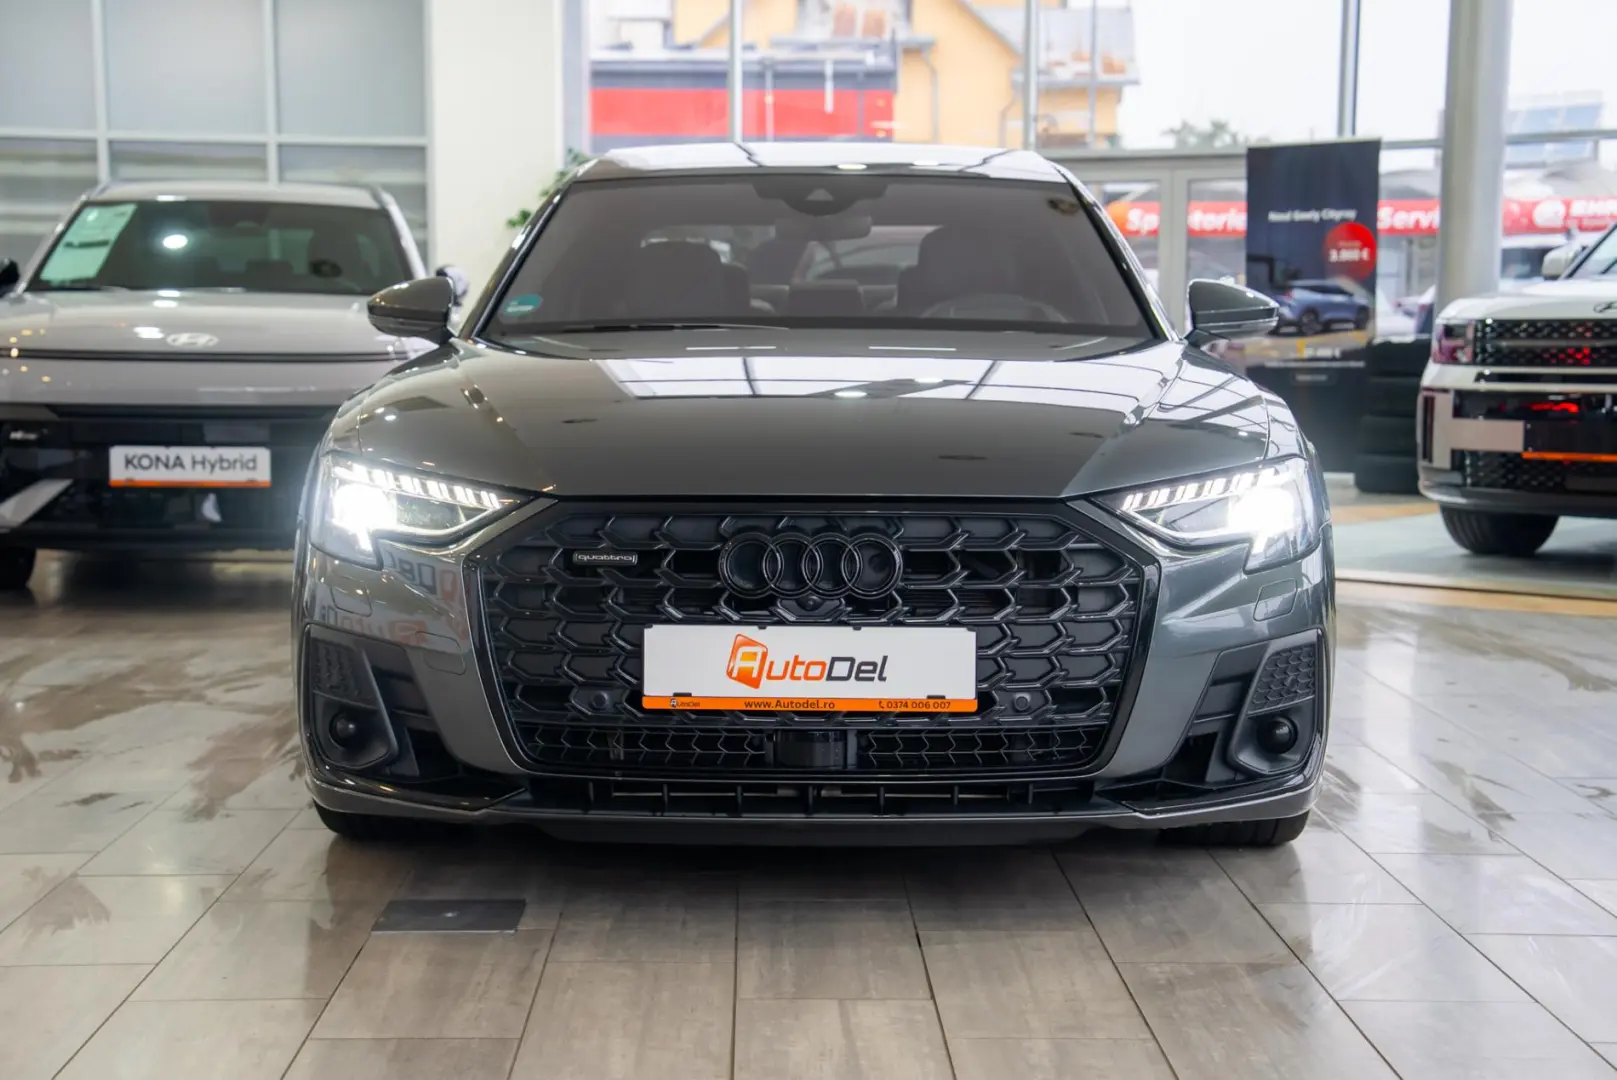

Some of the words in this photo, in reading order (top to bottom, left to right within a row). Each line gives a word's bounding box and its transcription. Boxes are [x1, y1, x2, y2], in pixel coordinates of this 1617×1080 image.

[124, 454, 186, 471] KONA
[191, 453, 258, 474] Hybrid
[727, 636, 888, 686] AutoDel
[744, 699, 836, 710] www.Autodel.ro
[886, 701, 909, 710] 0374
[911, 701, 931, 710] 006
[932, 701, 951, 710] 007
